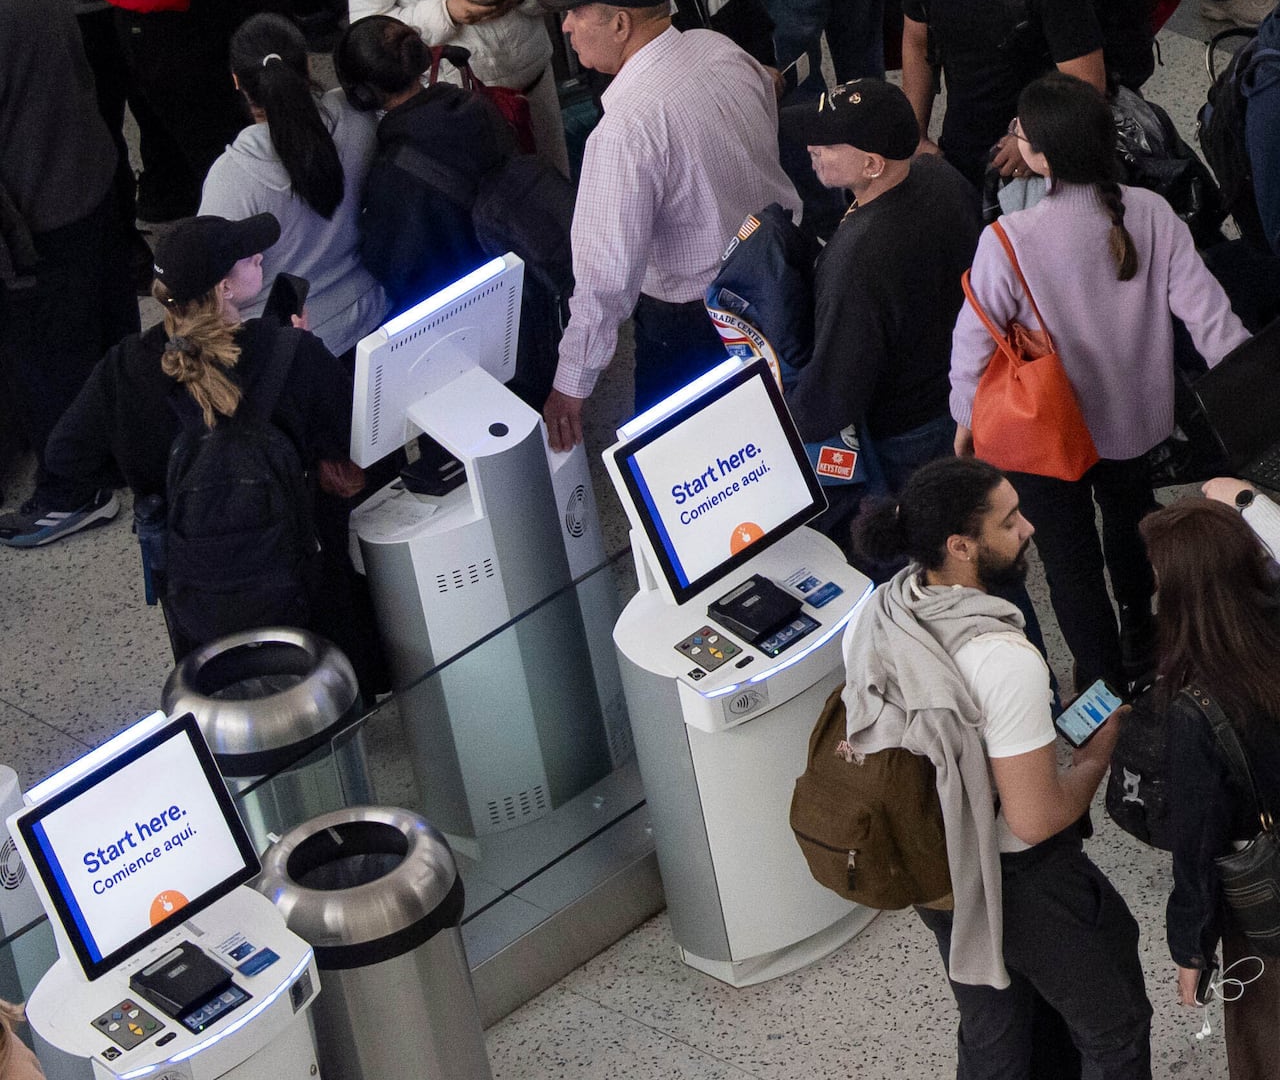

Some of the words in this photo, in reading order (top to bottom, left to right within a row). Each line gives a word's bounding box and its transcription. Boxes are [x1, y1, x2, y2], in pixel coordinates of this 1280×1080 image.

[709, 311, 736, 325] TRADE
[738, 321, 764, 349] CENTER
[671, 466, 719, 505] Start
[716, 443, 761, 476] here.
[680, 480, 740, 525] Comience
[743, 460, 771, 487] aquí.
[819, 462, 852, 476] KEYSTONE
[83, 830, 137, 873] Start
[134, 805, 187, 841] here.
[92, 847, 161, 895] Comience
[164, 822, 197, 851] aquí.
